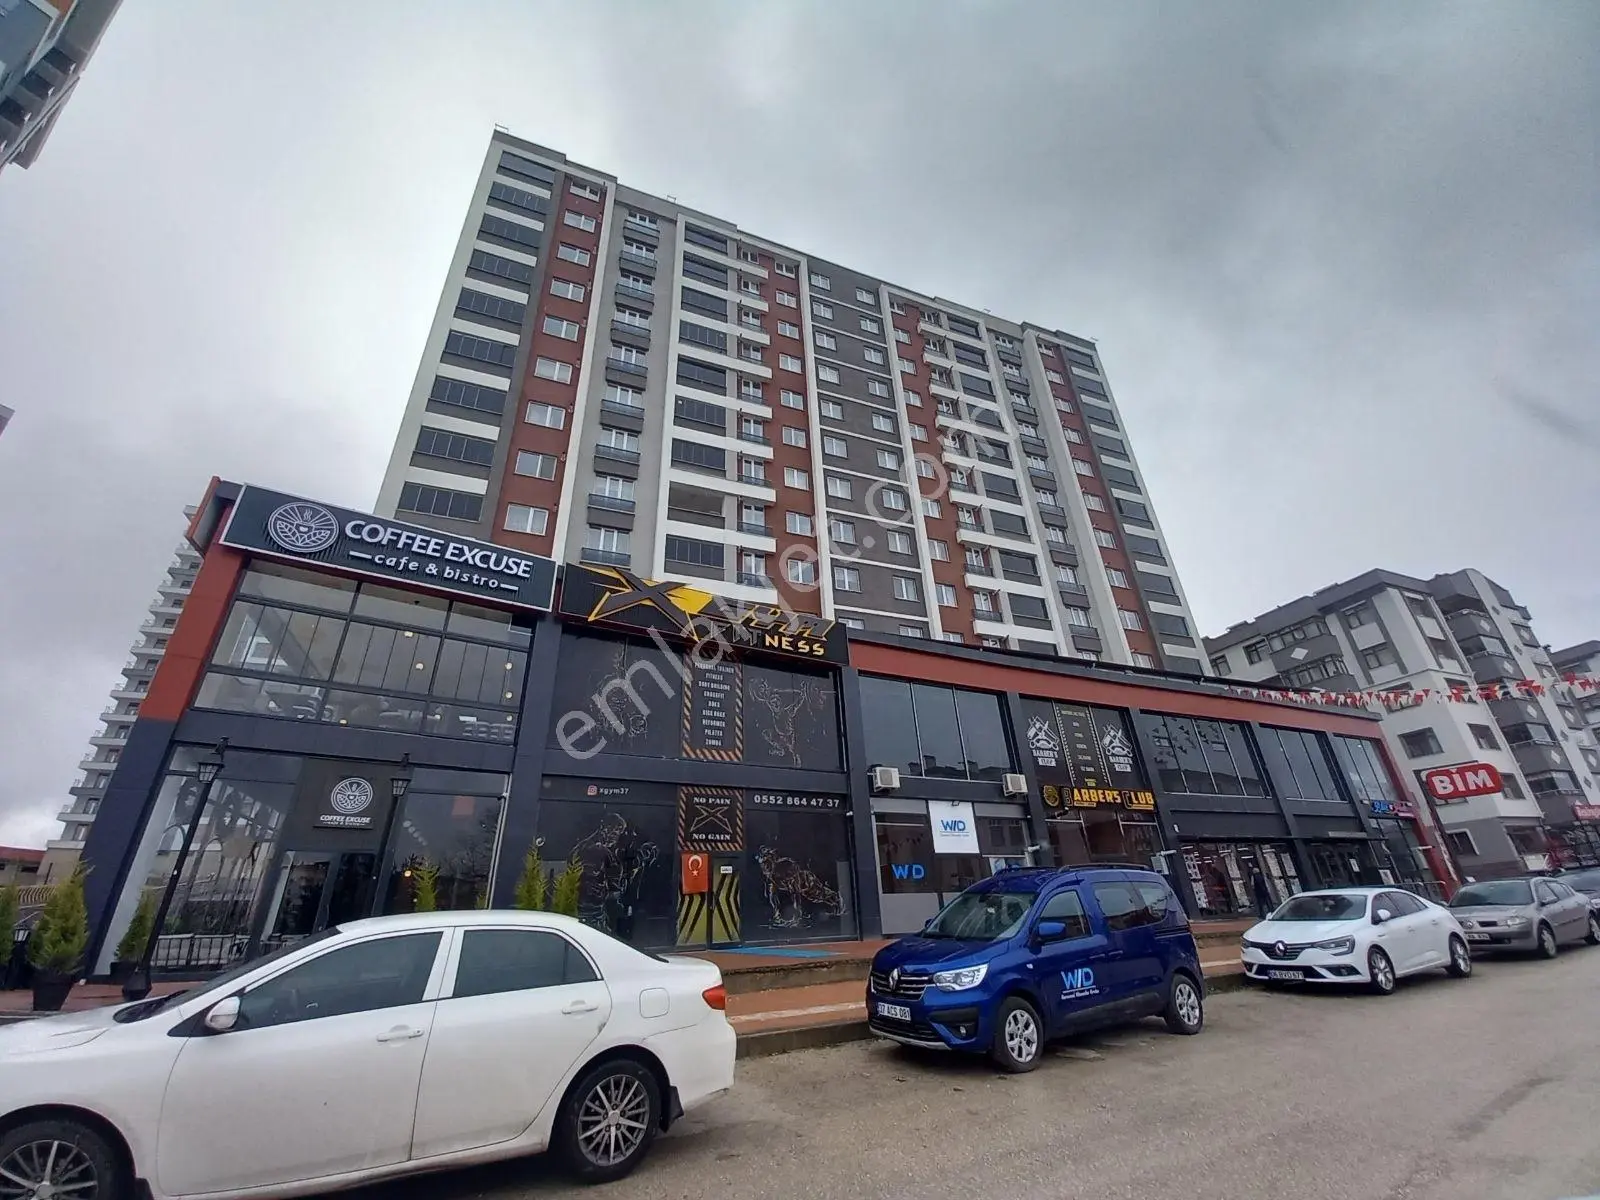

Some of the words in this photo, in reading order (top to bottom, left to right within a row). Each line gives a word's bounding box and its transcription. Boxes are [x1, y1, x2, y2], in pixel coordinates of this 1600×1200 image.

[344, 519, 444, 558] COFFEE
[444, 541, 533, 579] EXCUSE
[373, 552, 418, 573] cafe
[424, 561, 439, 576] &
[443, 566, 499, 589] bistro
[693, 796, 706, 804] NO
[753, 794, 783, 804] 0552
[786, 796, 808, 806] 864
[810, 798, 824, 807] 47
[826, 798, 840, 807] 37
[320, 814, 345, 822] COFFEE
[345, 815, 371, 824] EXCUSE
[707, 833, 731, 841] GAIN
